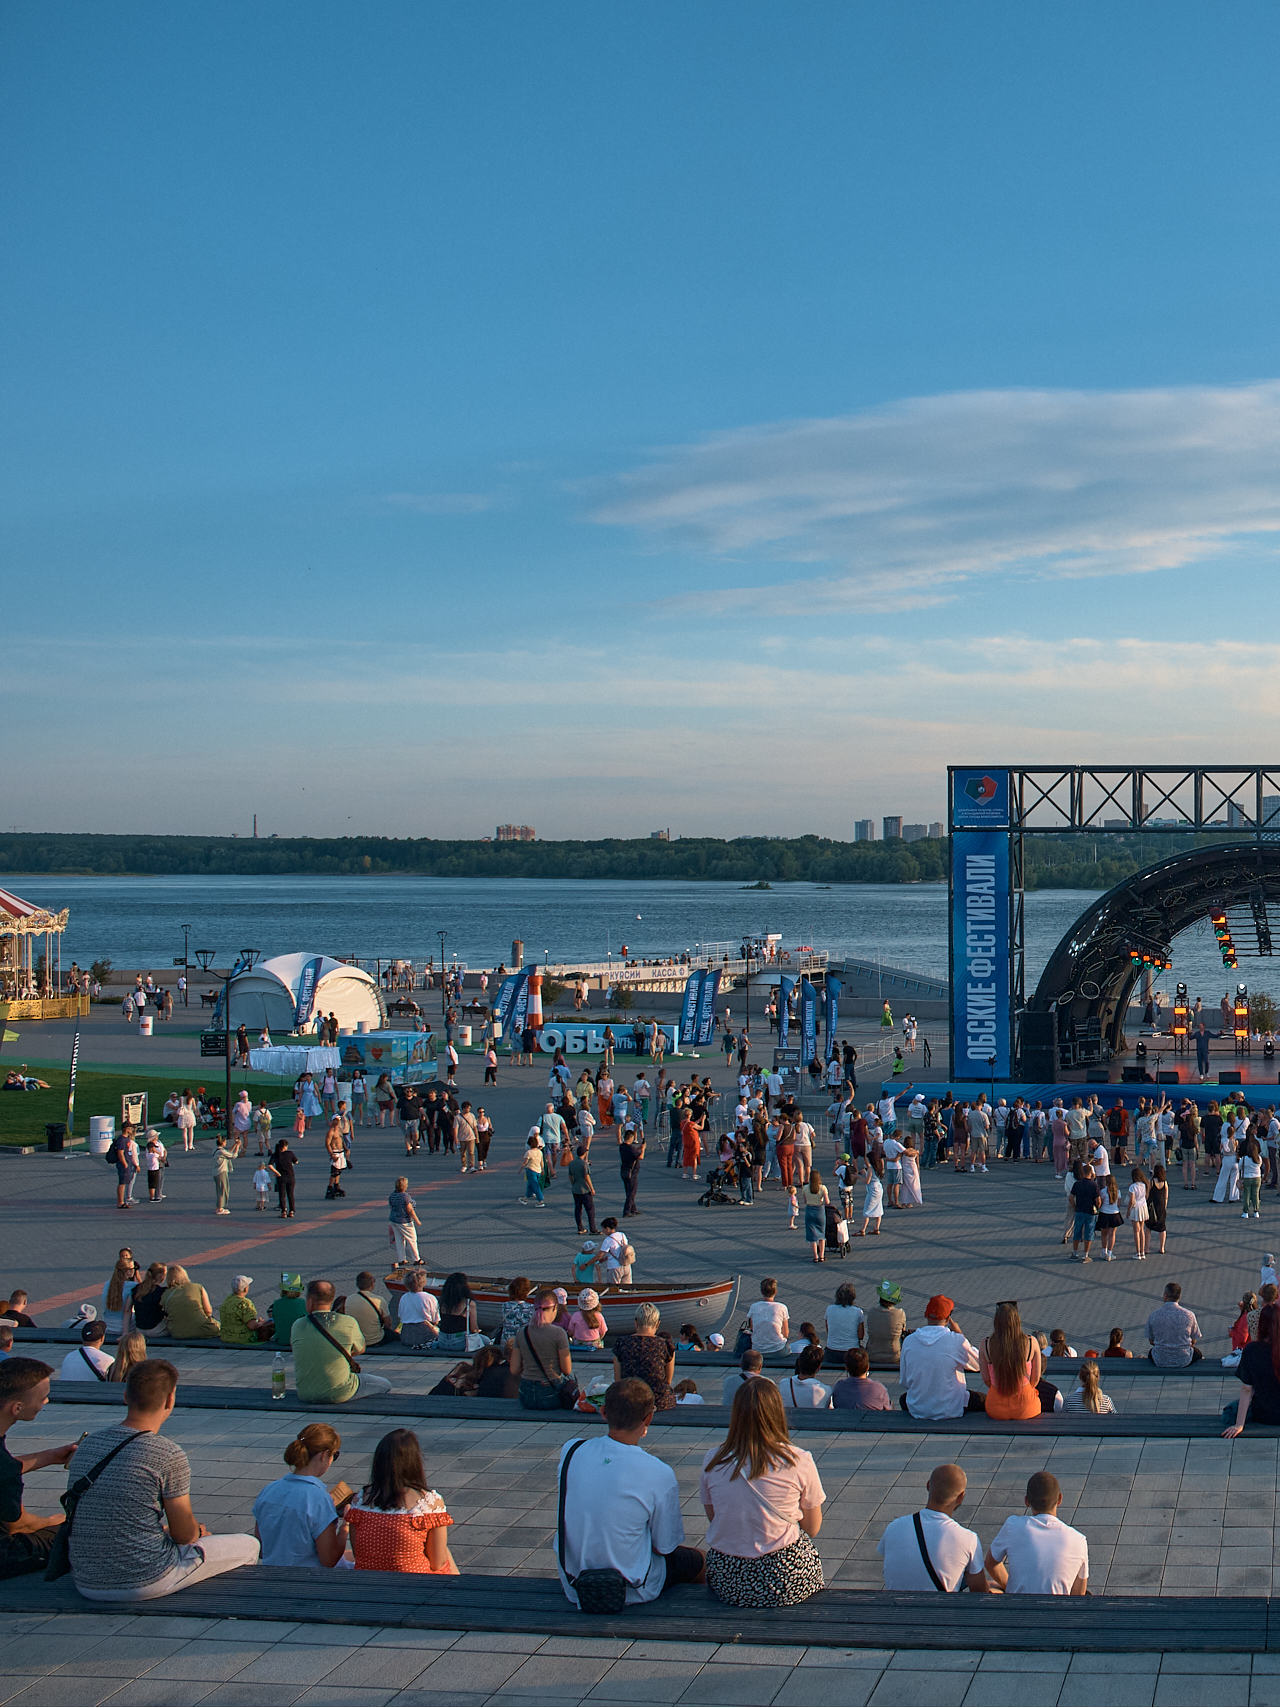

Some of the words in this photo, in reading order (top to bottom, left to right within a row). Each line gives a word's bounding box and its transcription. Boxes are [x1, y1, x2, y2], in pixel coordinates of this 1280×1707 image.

[966, 855, 996, 978] ФЕСТИВАЛИ
[652, 968, 677, 978] КАССА
[687, 980, 699, 1017] ФЕСТИВАЛИ
[702, 981, 714, 1019] ФЕСТИВАЛИ
[966, 983, 996, 1060] ОБСКИЕ
[540, 1029, 605, 1053] ОБЬ
